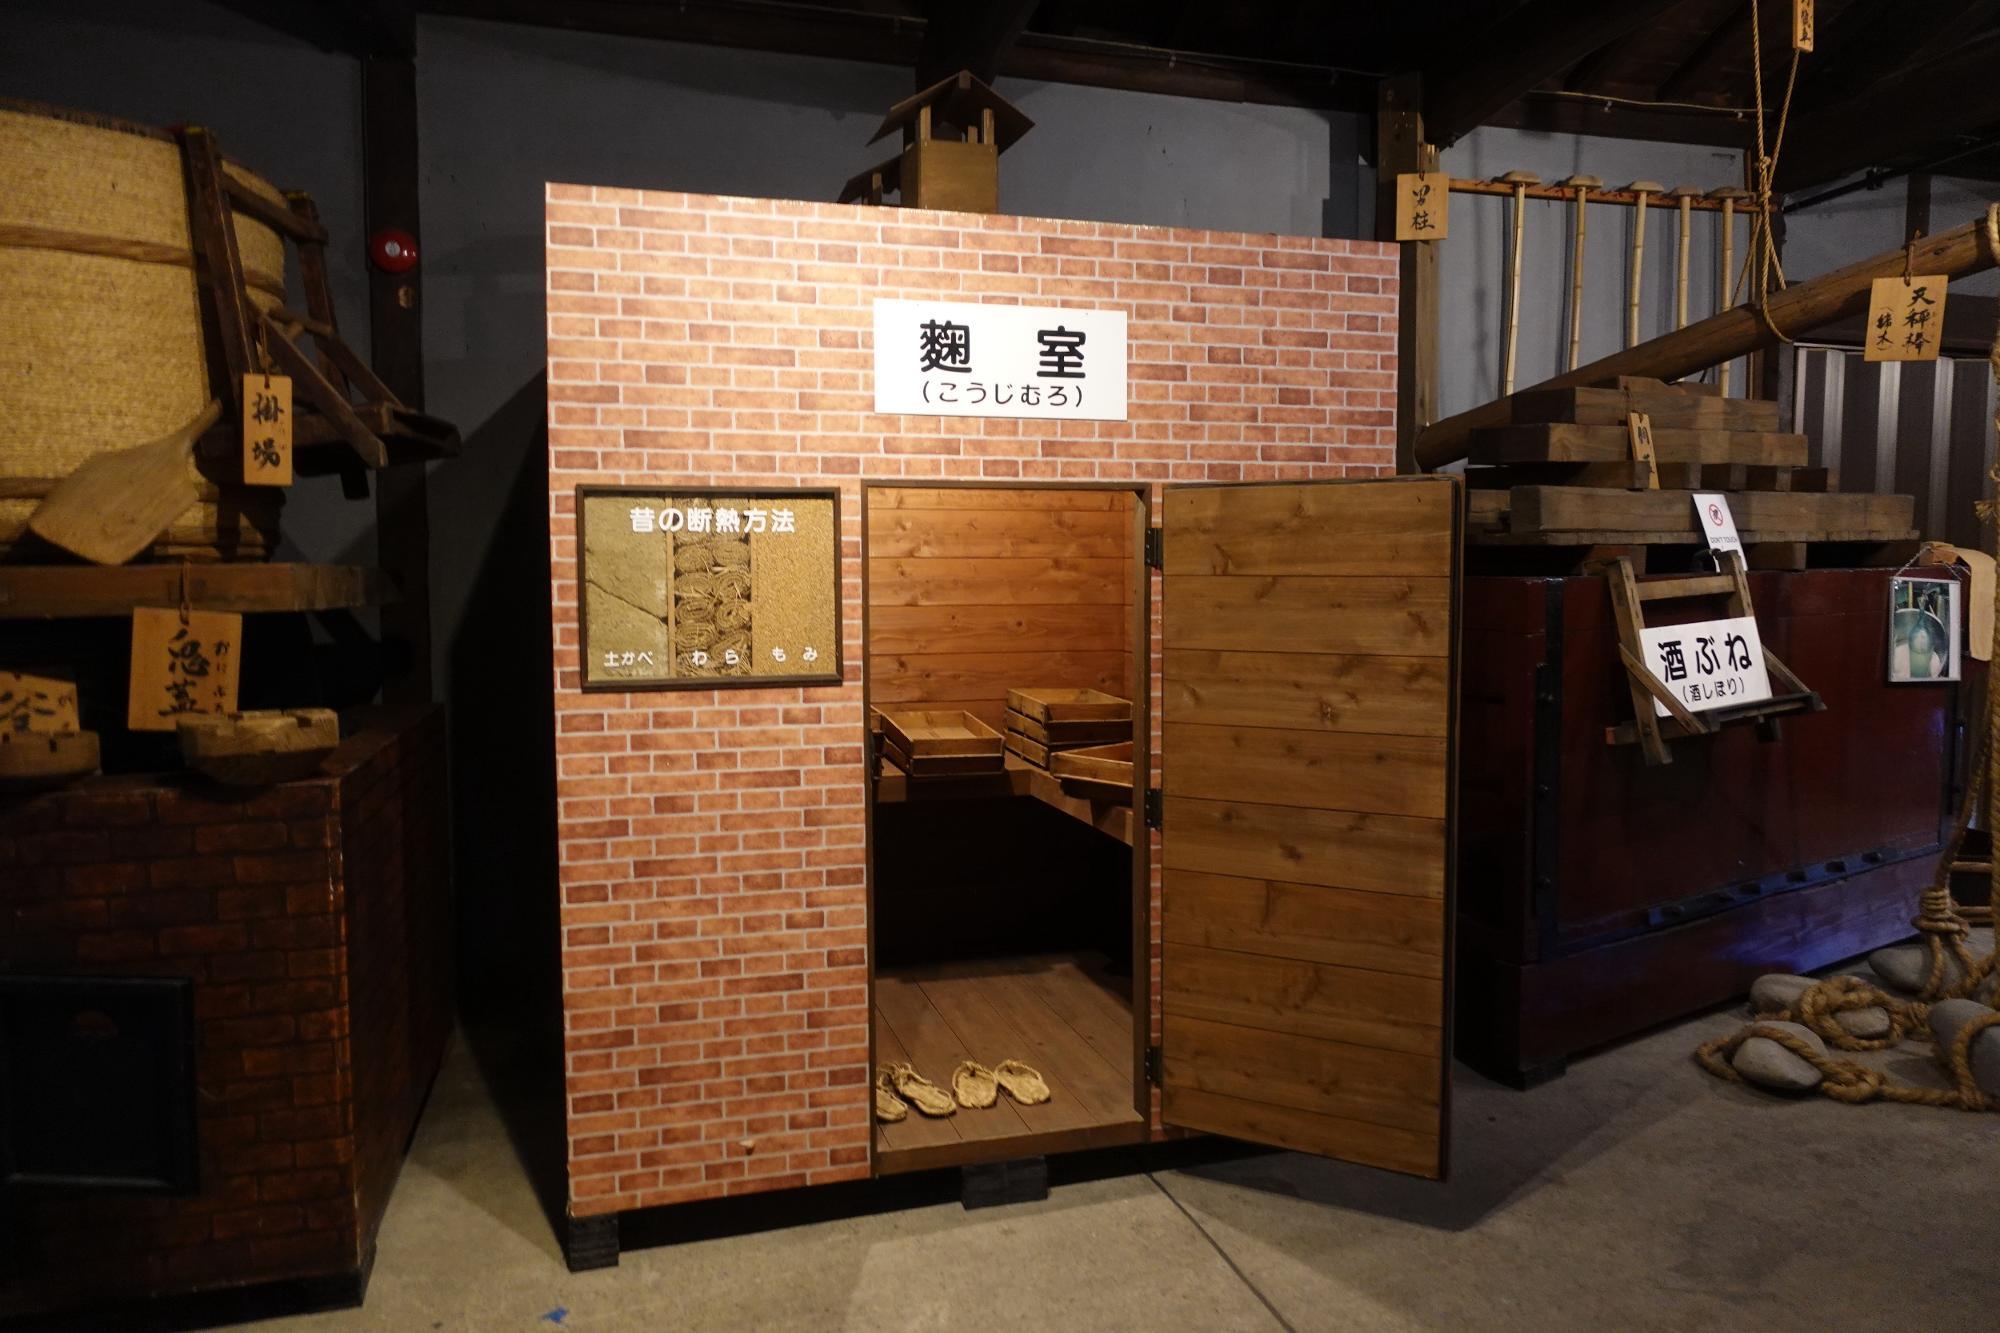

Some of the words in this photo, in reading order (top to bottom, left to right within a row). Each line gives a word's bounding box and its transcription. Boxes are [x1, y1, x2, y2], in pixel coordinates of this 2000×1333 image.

[922, 381, 1083, 408] （こうじむろ）
[629, 507, 796, 533] 昔の断熱方法
[603, 650, 654, 667] 土かべ
[692, 649, 740, 666] わら
[772, 646, 818, 663] もみ
[1657, 632, 1753, 683] 酒ぶね
